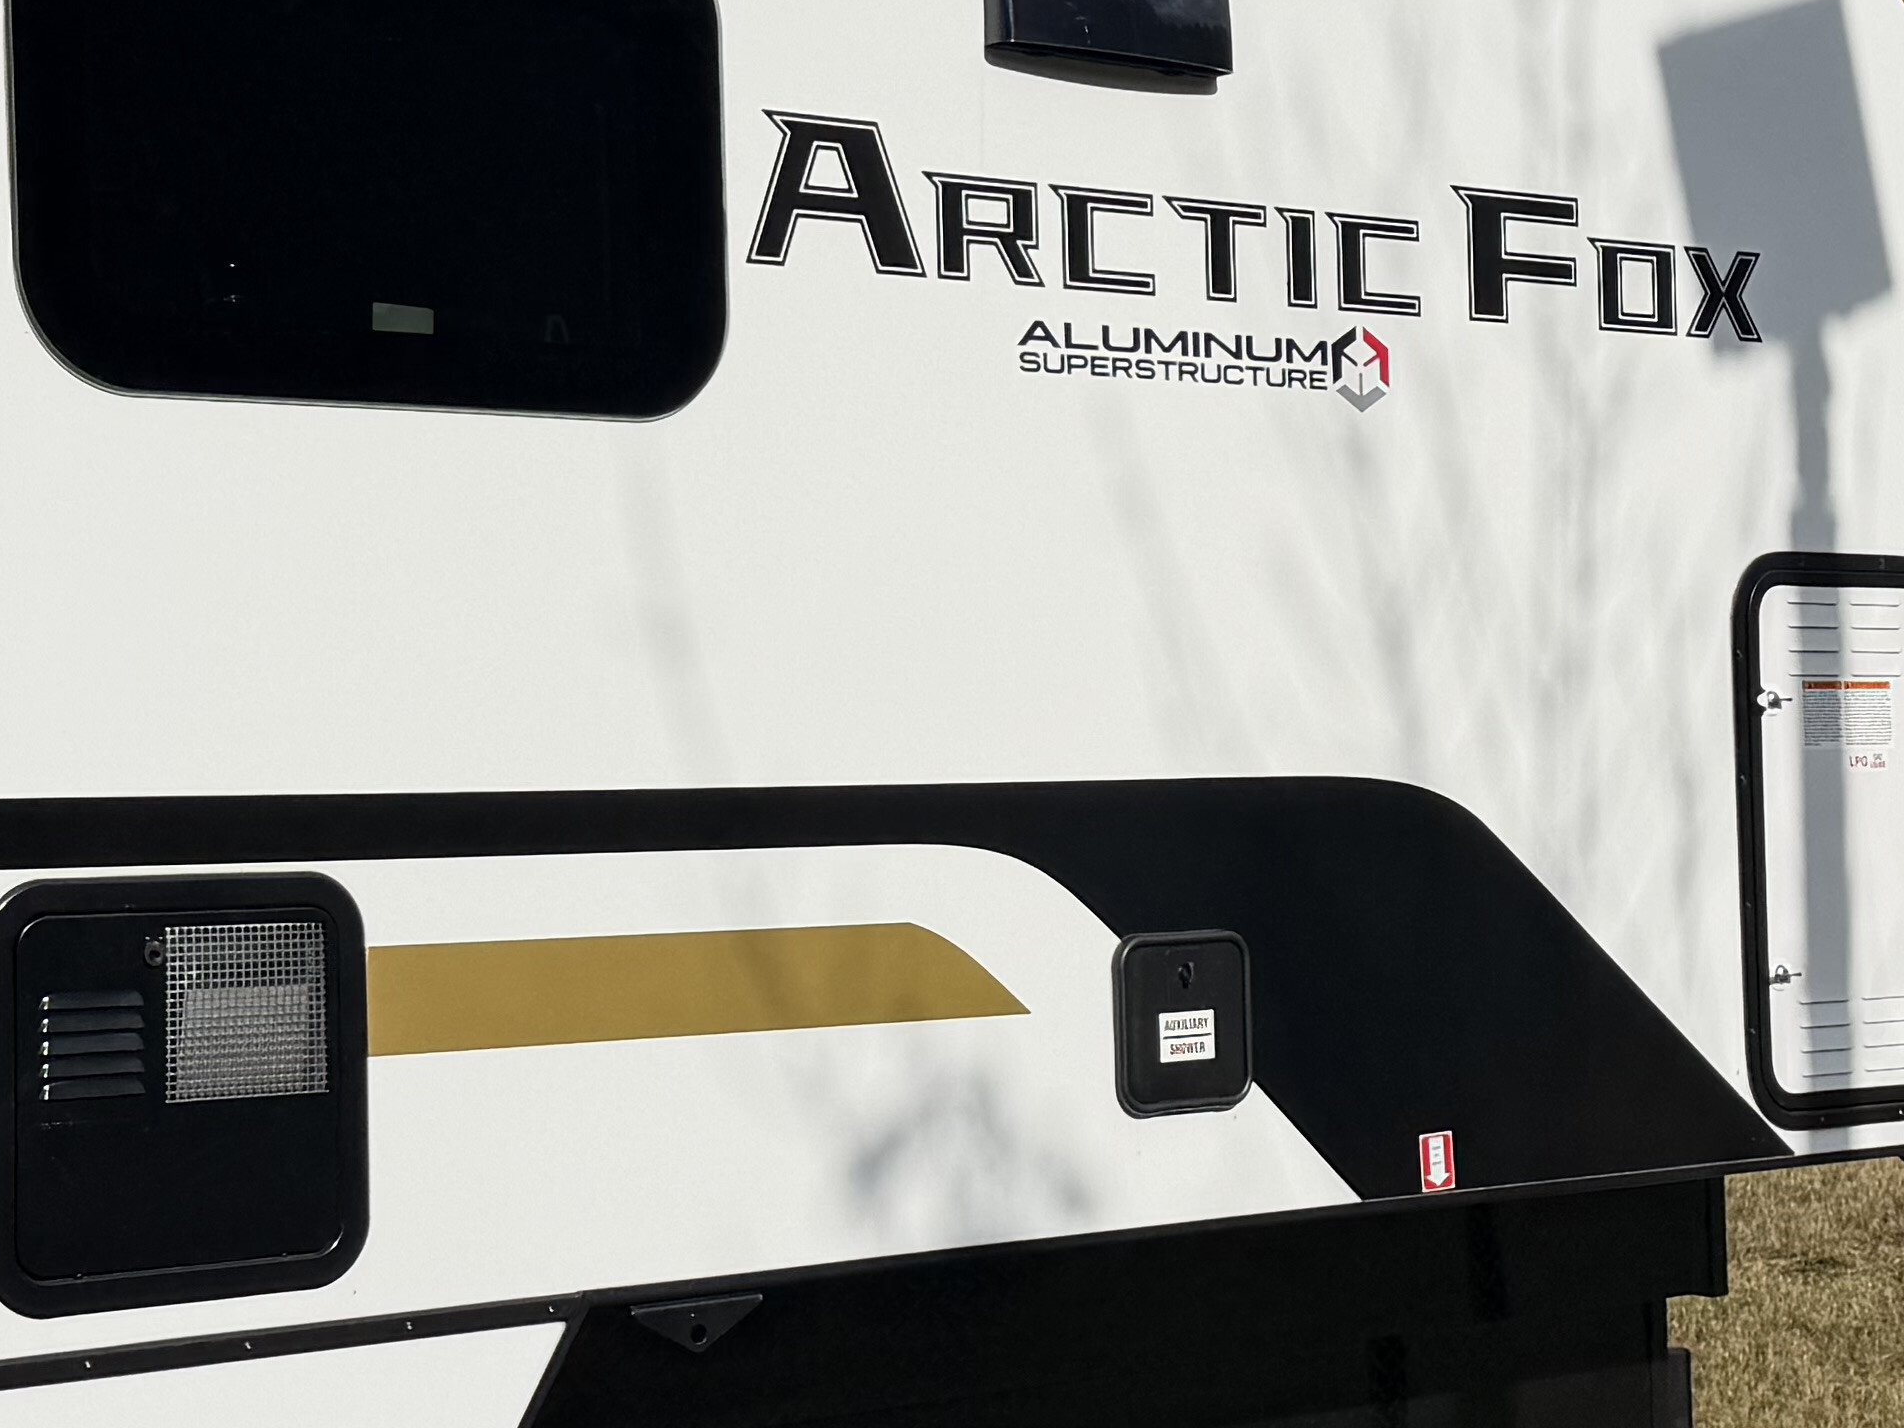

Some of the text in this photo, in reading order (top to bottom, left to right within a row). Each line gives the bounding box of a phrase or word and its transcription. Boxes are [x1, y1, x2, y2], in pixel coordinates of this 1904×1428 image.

[746, 109, 1763, 343] ARCTIC FOX
[1017, 320, 1329, 366] ALUMINUM
[1018, 351, 1328, 391] SUPERSTRUCTURE
